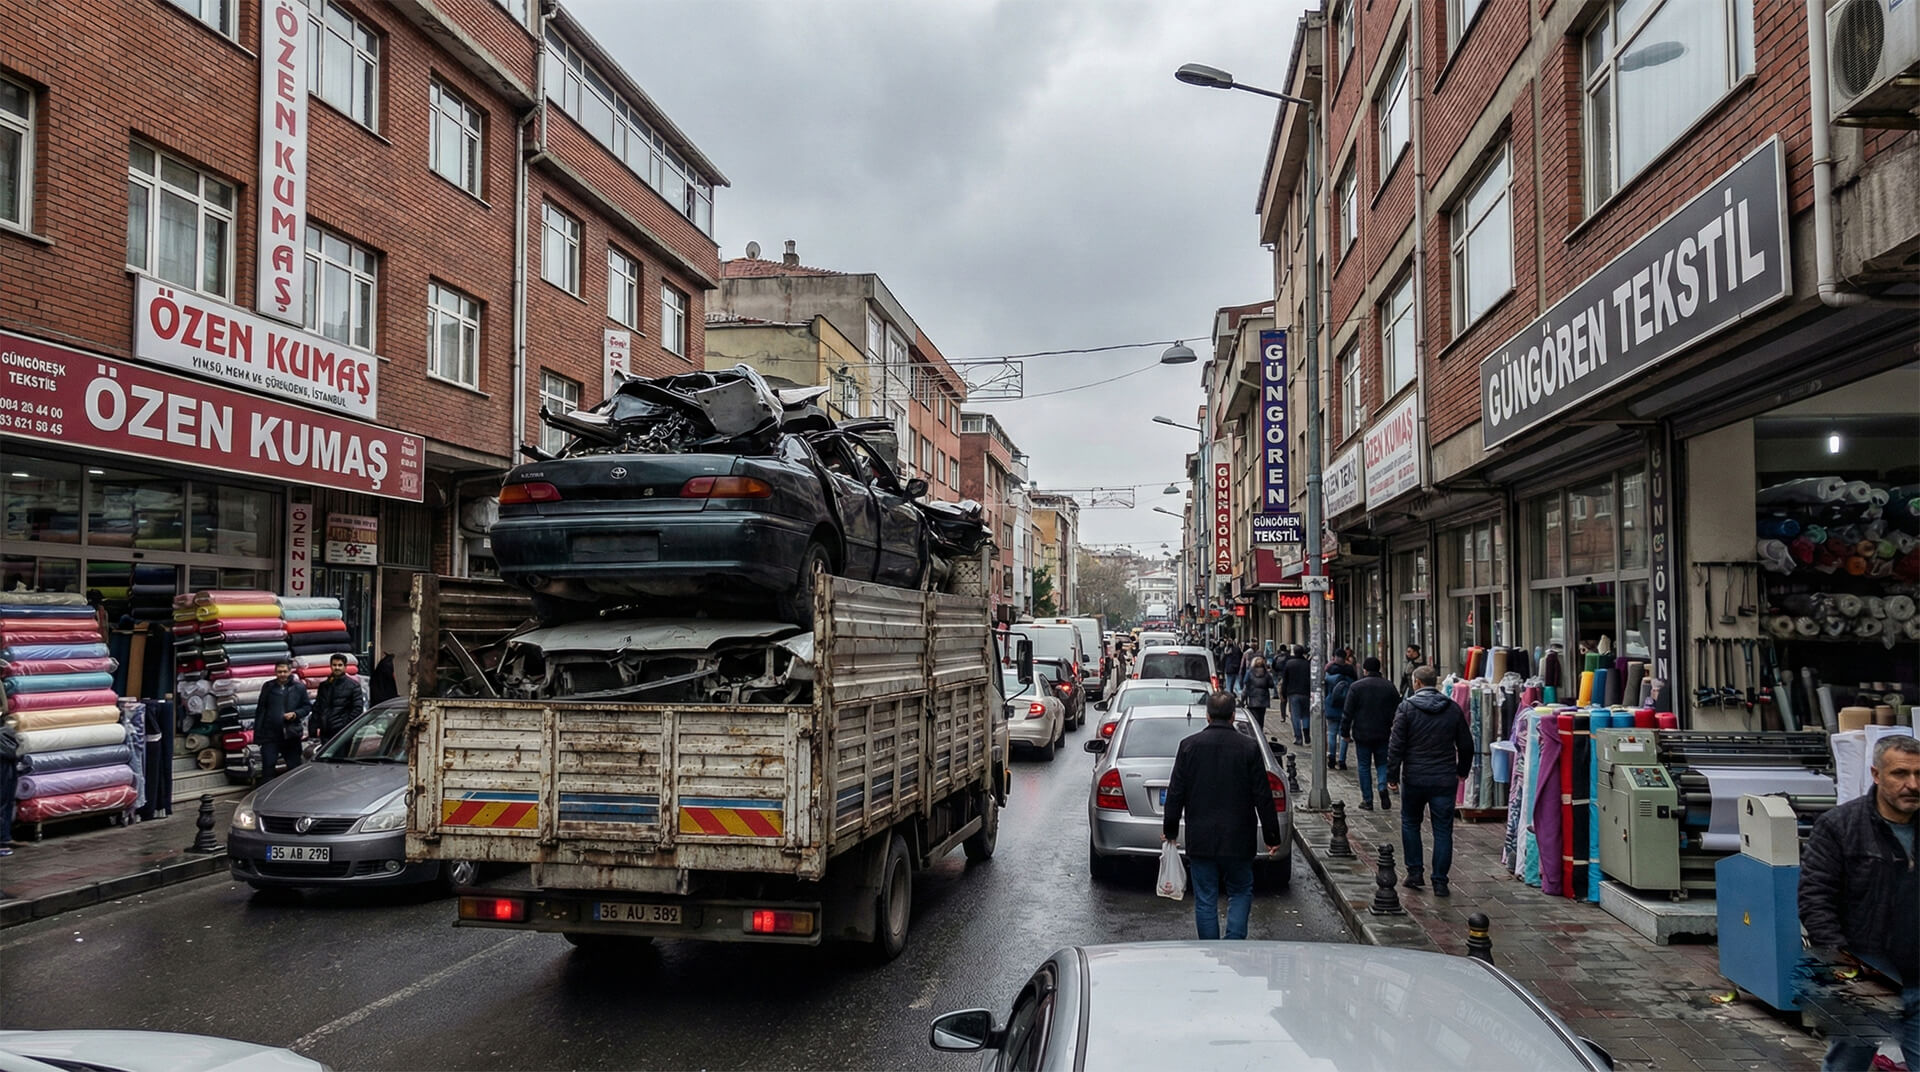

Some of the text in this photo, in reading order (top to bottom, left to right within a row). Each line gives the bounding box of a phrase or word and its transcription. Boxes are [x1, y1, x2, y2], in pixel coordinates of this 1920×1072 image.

[272, 1, 299, 313] ÖZEN KUMAŞ
[150, 288, 371, 405] ÖZEN KUMAŞ
[1488, 187, 1766, 427] GÜNGÖREN TEKSTİL
[85, 364, 233, 454] ÖZEN
[250, 414, 389, 490] KUMAŞ
[1264, 343, 1285, 505] GÜNGÖREN
[291, 508, 307, 561] ÖZEN
[1254, 527, 1300, 542] TEKSTİL
[272, 847, 284, 859] 35
[601, 904, 618, 919] 36
[626, 905, 645, 920] AU
